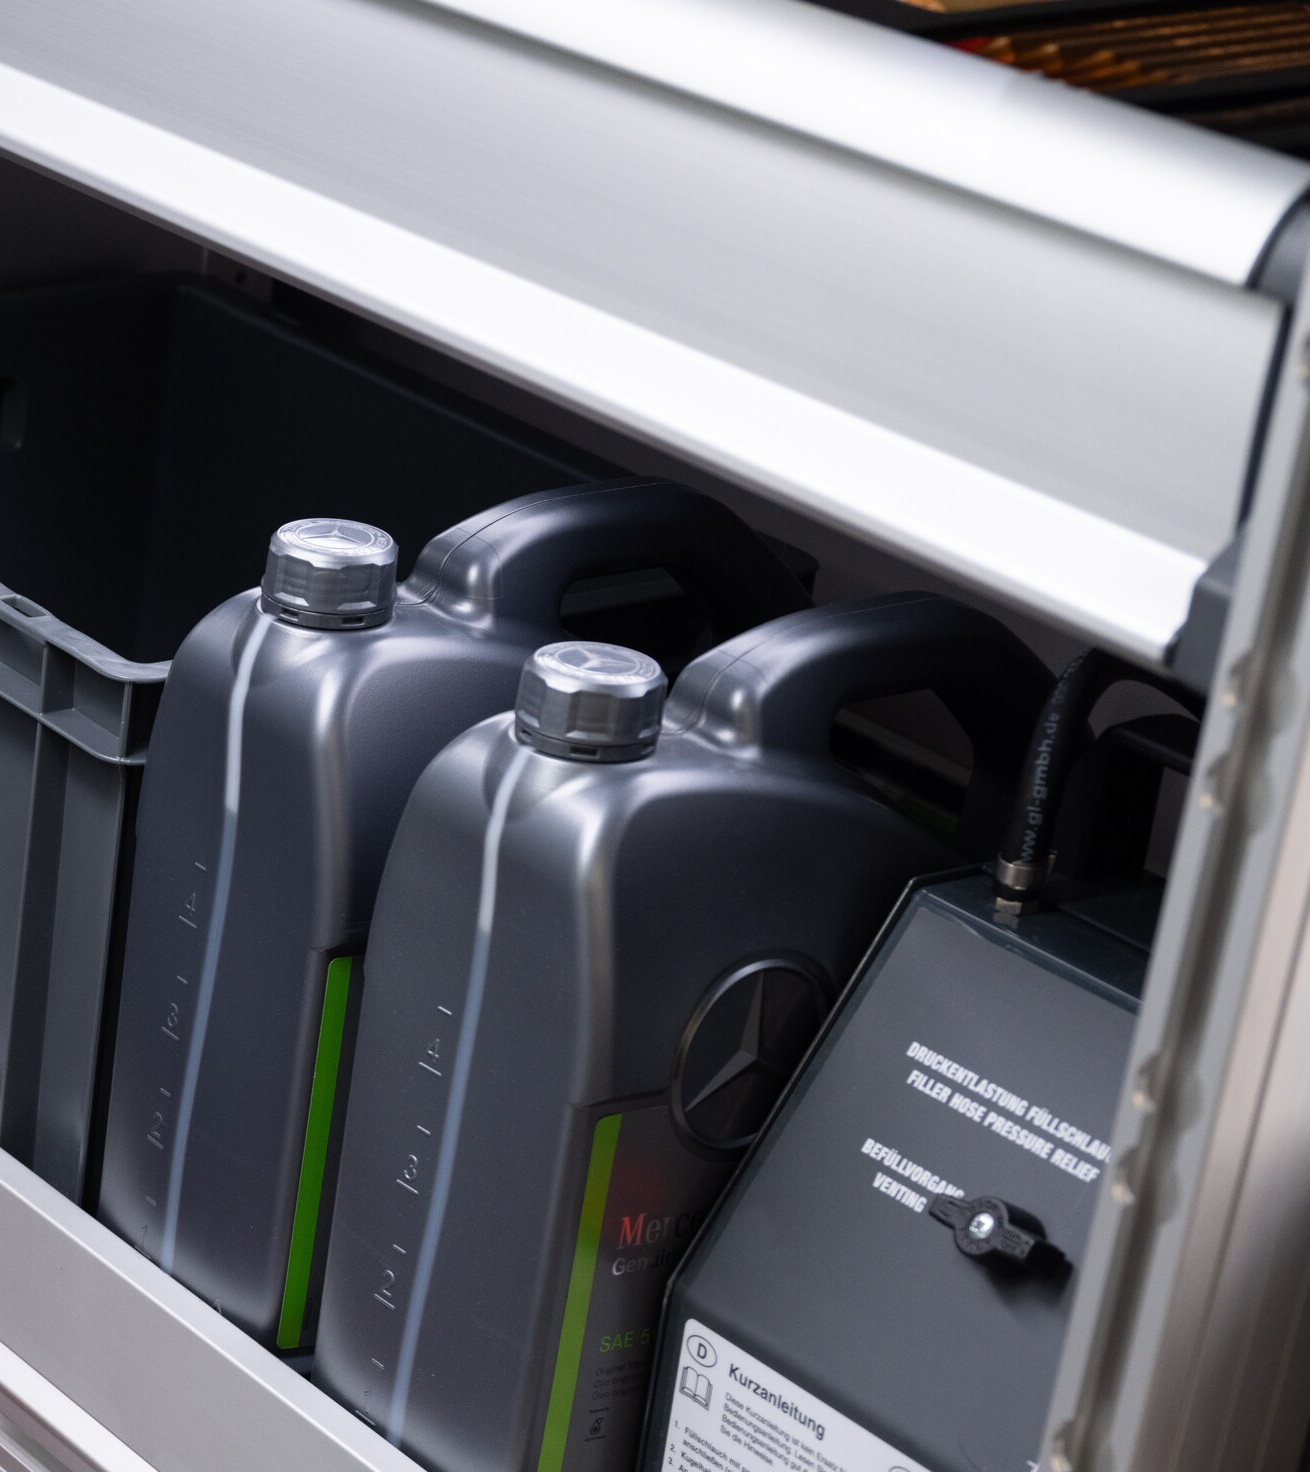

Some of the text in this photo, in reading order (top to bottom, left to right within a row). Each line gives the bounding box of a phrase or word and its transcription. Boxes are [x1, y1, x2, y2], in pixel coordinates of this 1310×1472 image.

[906, 1041, 1111, 1164] DRUCKENTLASTUNG FÜLLSCHLAU
[906, 1069, 1101, 1184] FILLER HOSE PRESSURE RELIEF
[872, 1172, 928, 1213] VENTING
[599, 1330, 635, 1353] SAE
[696, 1341, 707, 1360] D
[728, 1362, 825, 1441] Kurzanleitung
[674, 1419, 680, 1429] 1.
[683, 1425, 728, 1461] Füllschlauch
[728, 1457, 741, 1470] mit
